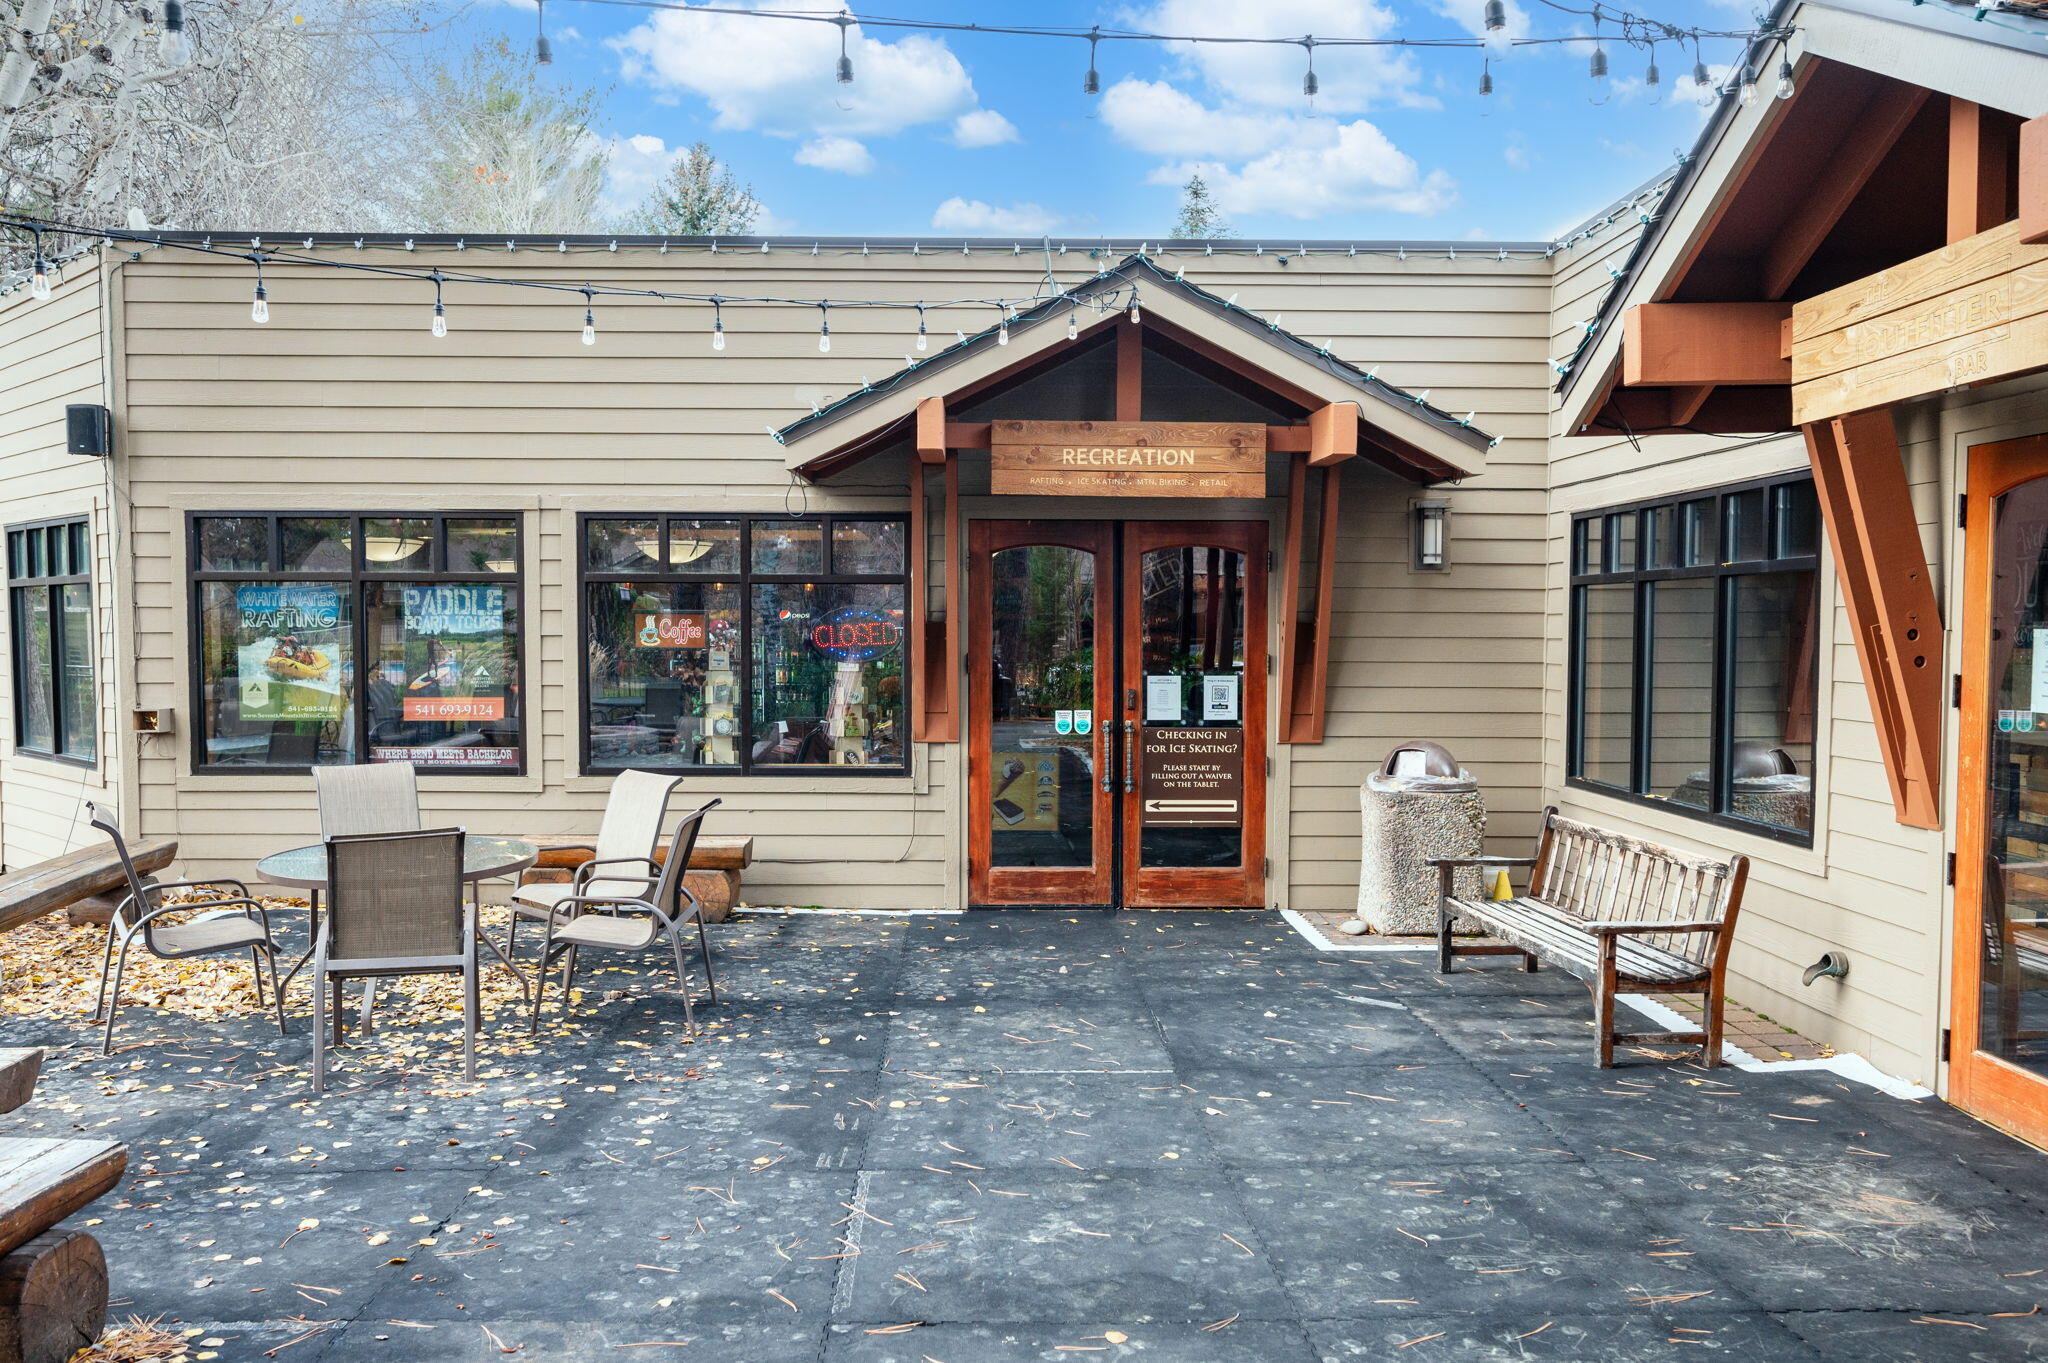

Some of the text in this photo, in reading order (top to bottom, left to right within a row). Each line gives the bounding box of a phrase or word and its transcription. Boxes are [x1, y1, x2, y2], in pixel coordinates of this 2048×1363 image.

[1864, 282, 1889, 306] THE
[1862, 289, 2002, 358] OUTFITTER
[1954, 351, 1988, 379] BAR
[1062, 448, 1195, 466] RECREATION
[1030, 477, 1229, 487] RAFTING ICE SKATING MTN. BIKING RETAIL
[240, 591, 337, 607] WHITEWATER
[403, 589, 503, 616] PADDLE
[241, 607, 337, 628] RAFTING
[404, 615, 501, 630] BOARD TOURS
[659, 618, 702, 645] Coffee
[814, 622, 898, 648] CLOSED
[415, 704, 494, 716] 541 693-9124
[1156, 730, 1227, 740] CHECKING IN
[376, 748, 513, 760] WHERE BEND MEETS BACHELOR
[1146, 744, 1238, 753] FOR ICE SKATING?
